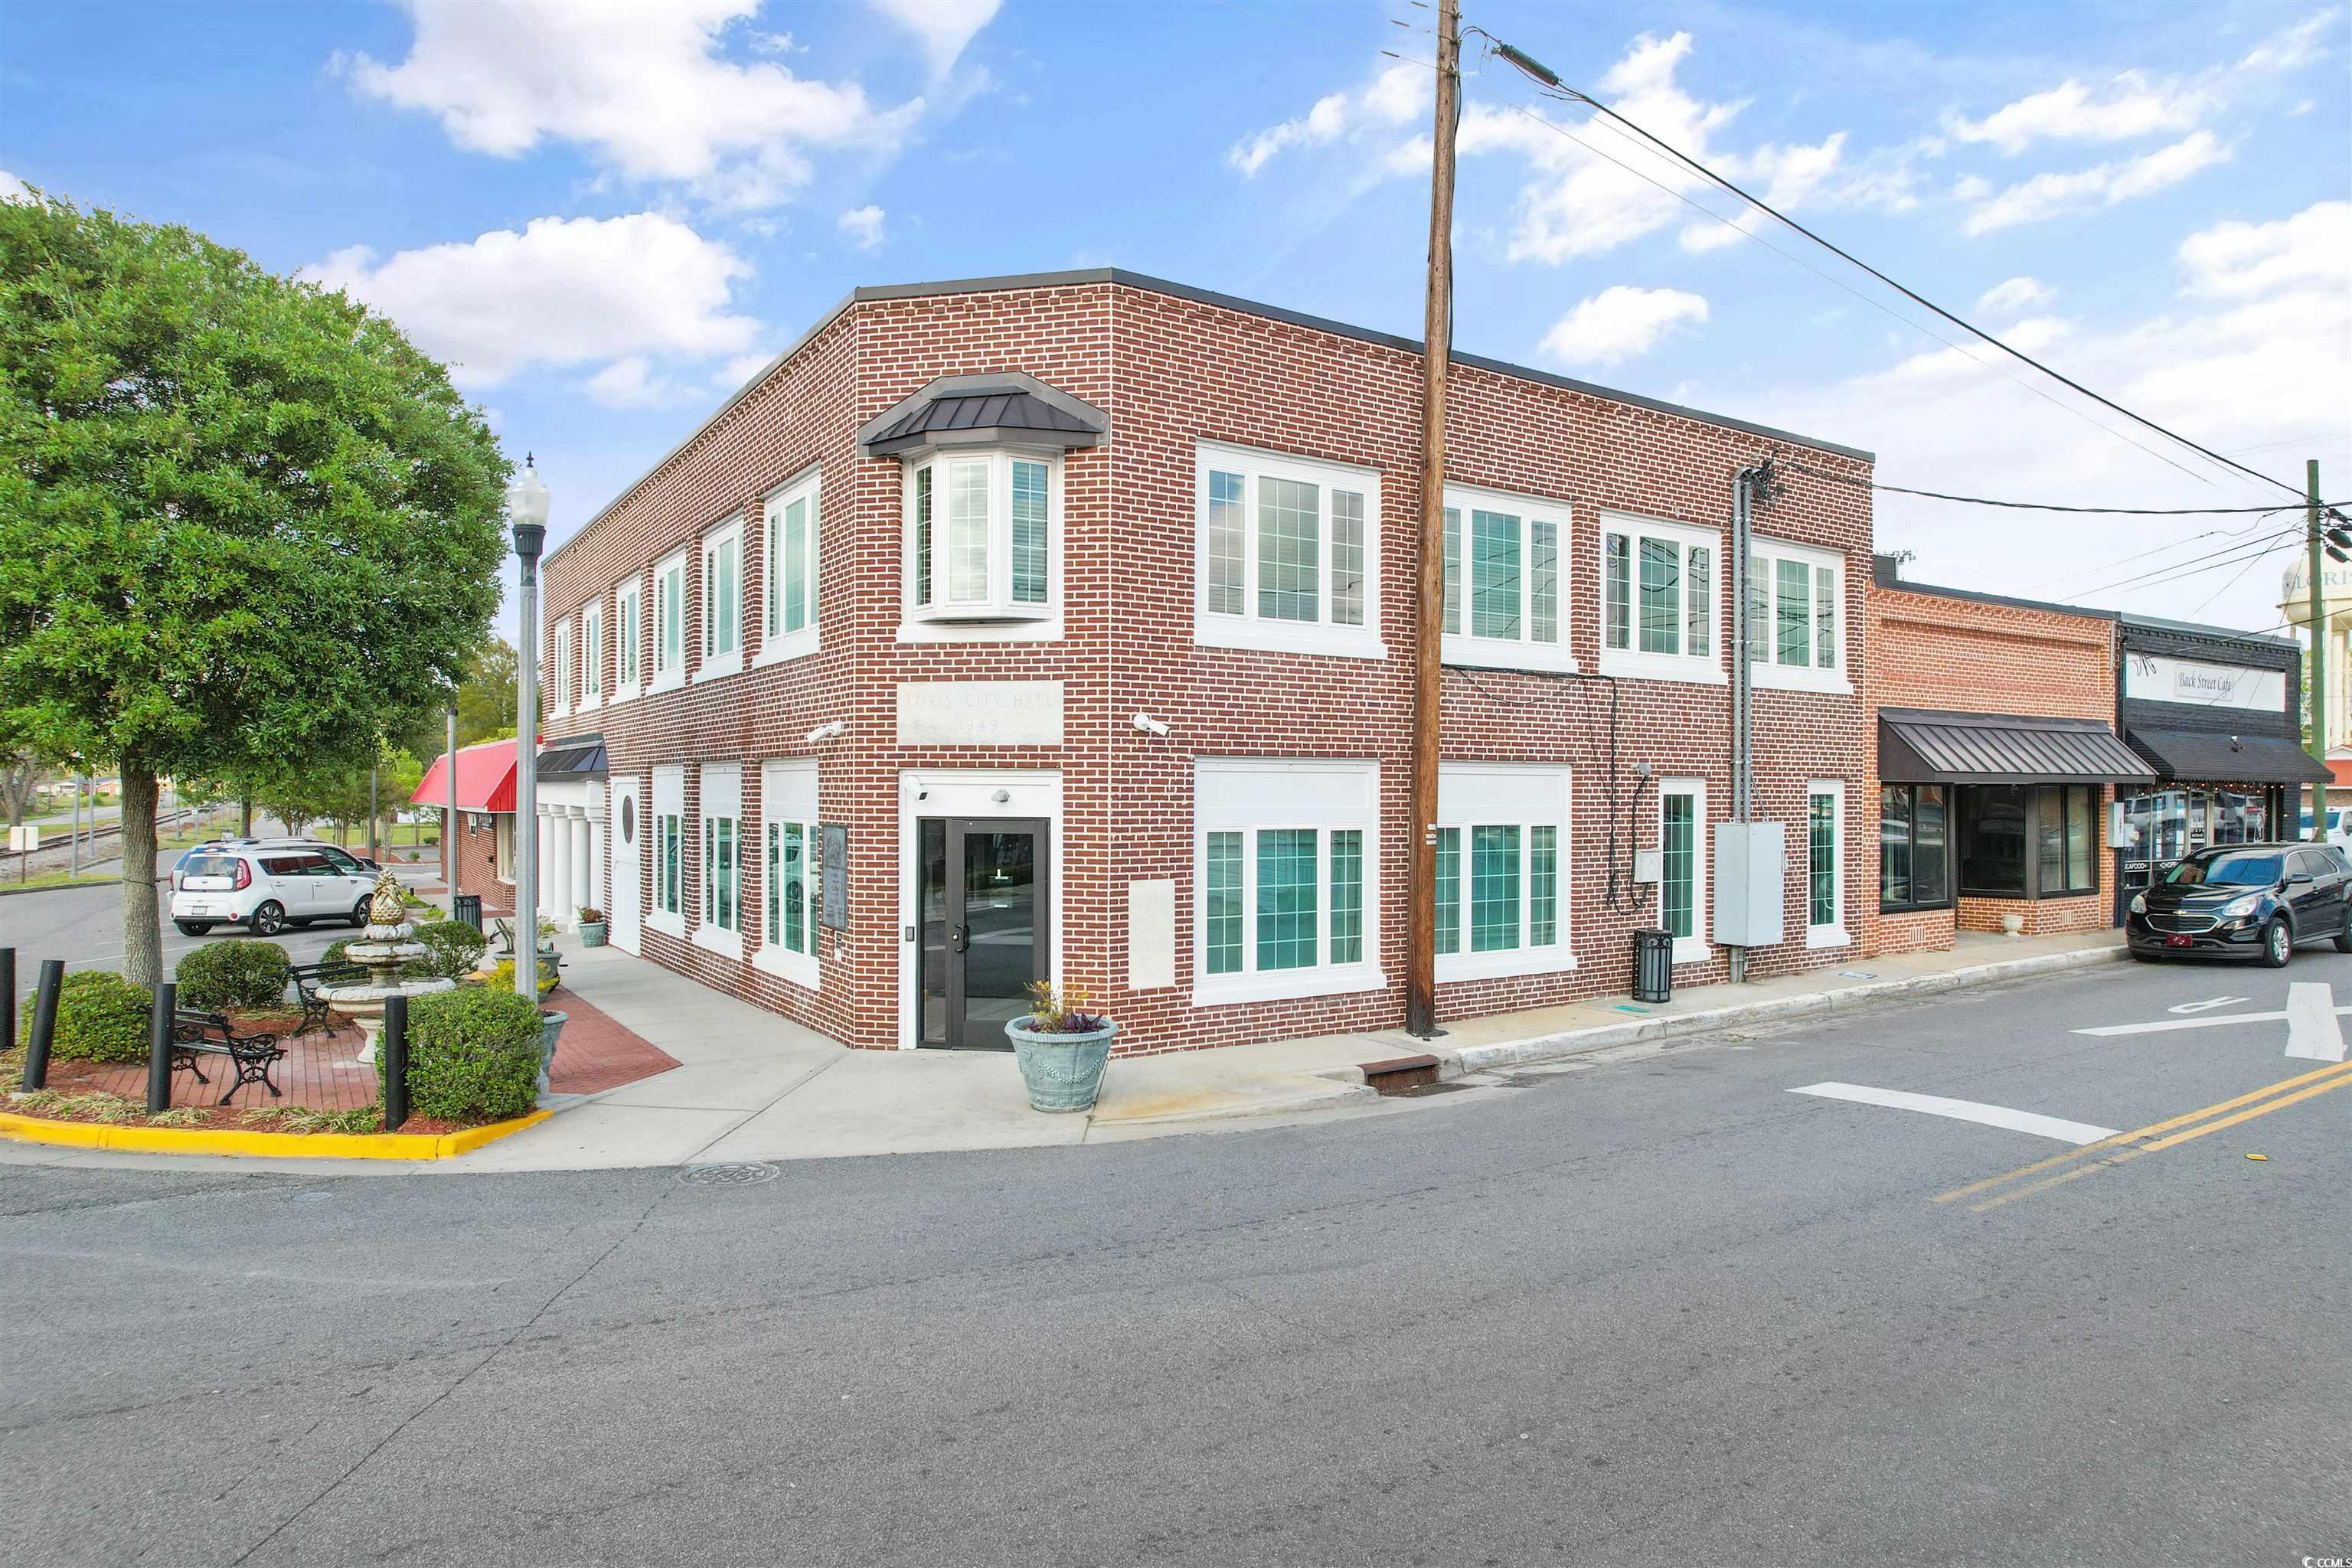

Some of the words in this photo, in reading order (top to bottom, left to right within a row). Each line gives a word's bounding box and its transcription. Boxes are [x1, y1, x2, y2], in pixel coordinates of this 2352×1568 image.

[2297, 570, 2352, 589] LRI
[2180, 671, 2196, 688] Back
[2197, 673, 2216, 689] Street
[906, 694, 950, 708] LORIS
[965, 693, 1000, 707] CITY
[1012, 693, 1054, 707] HALL
[959, 718, 998, 732] 1949
